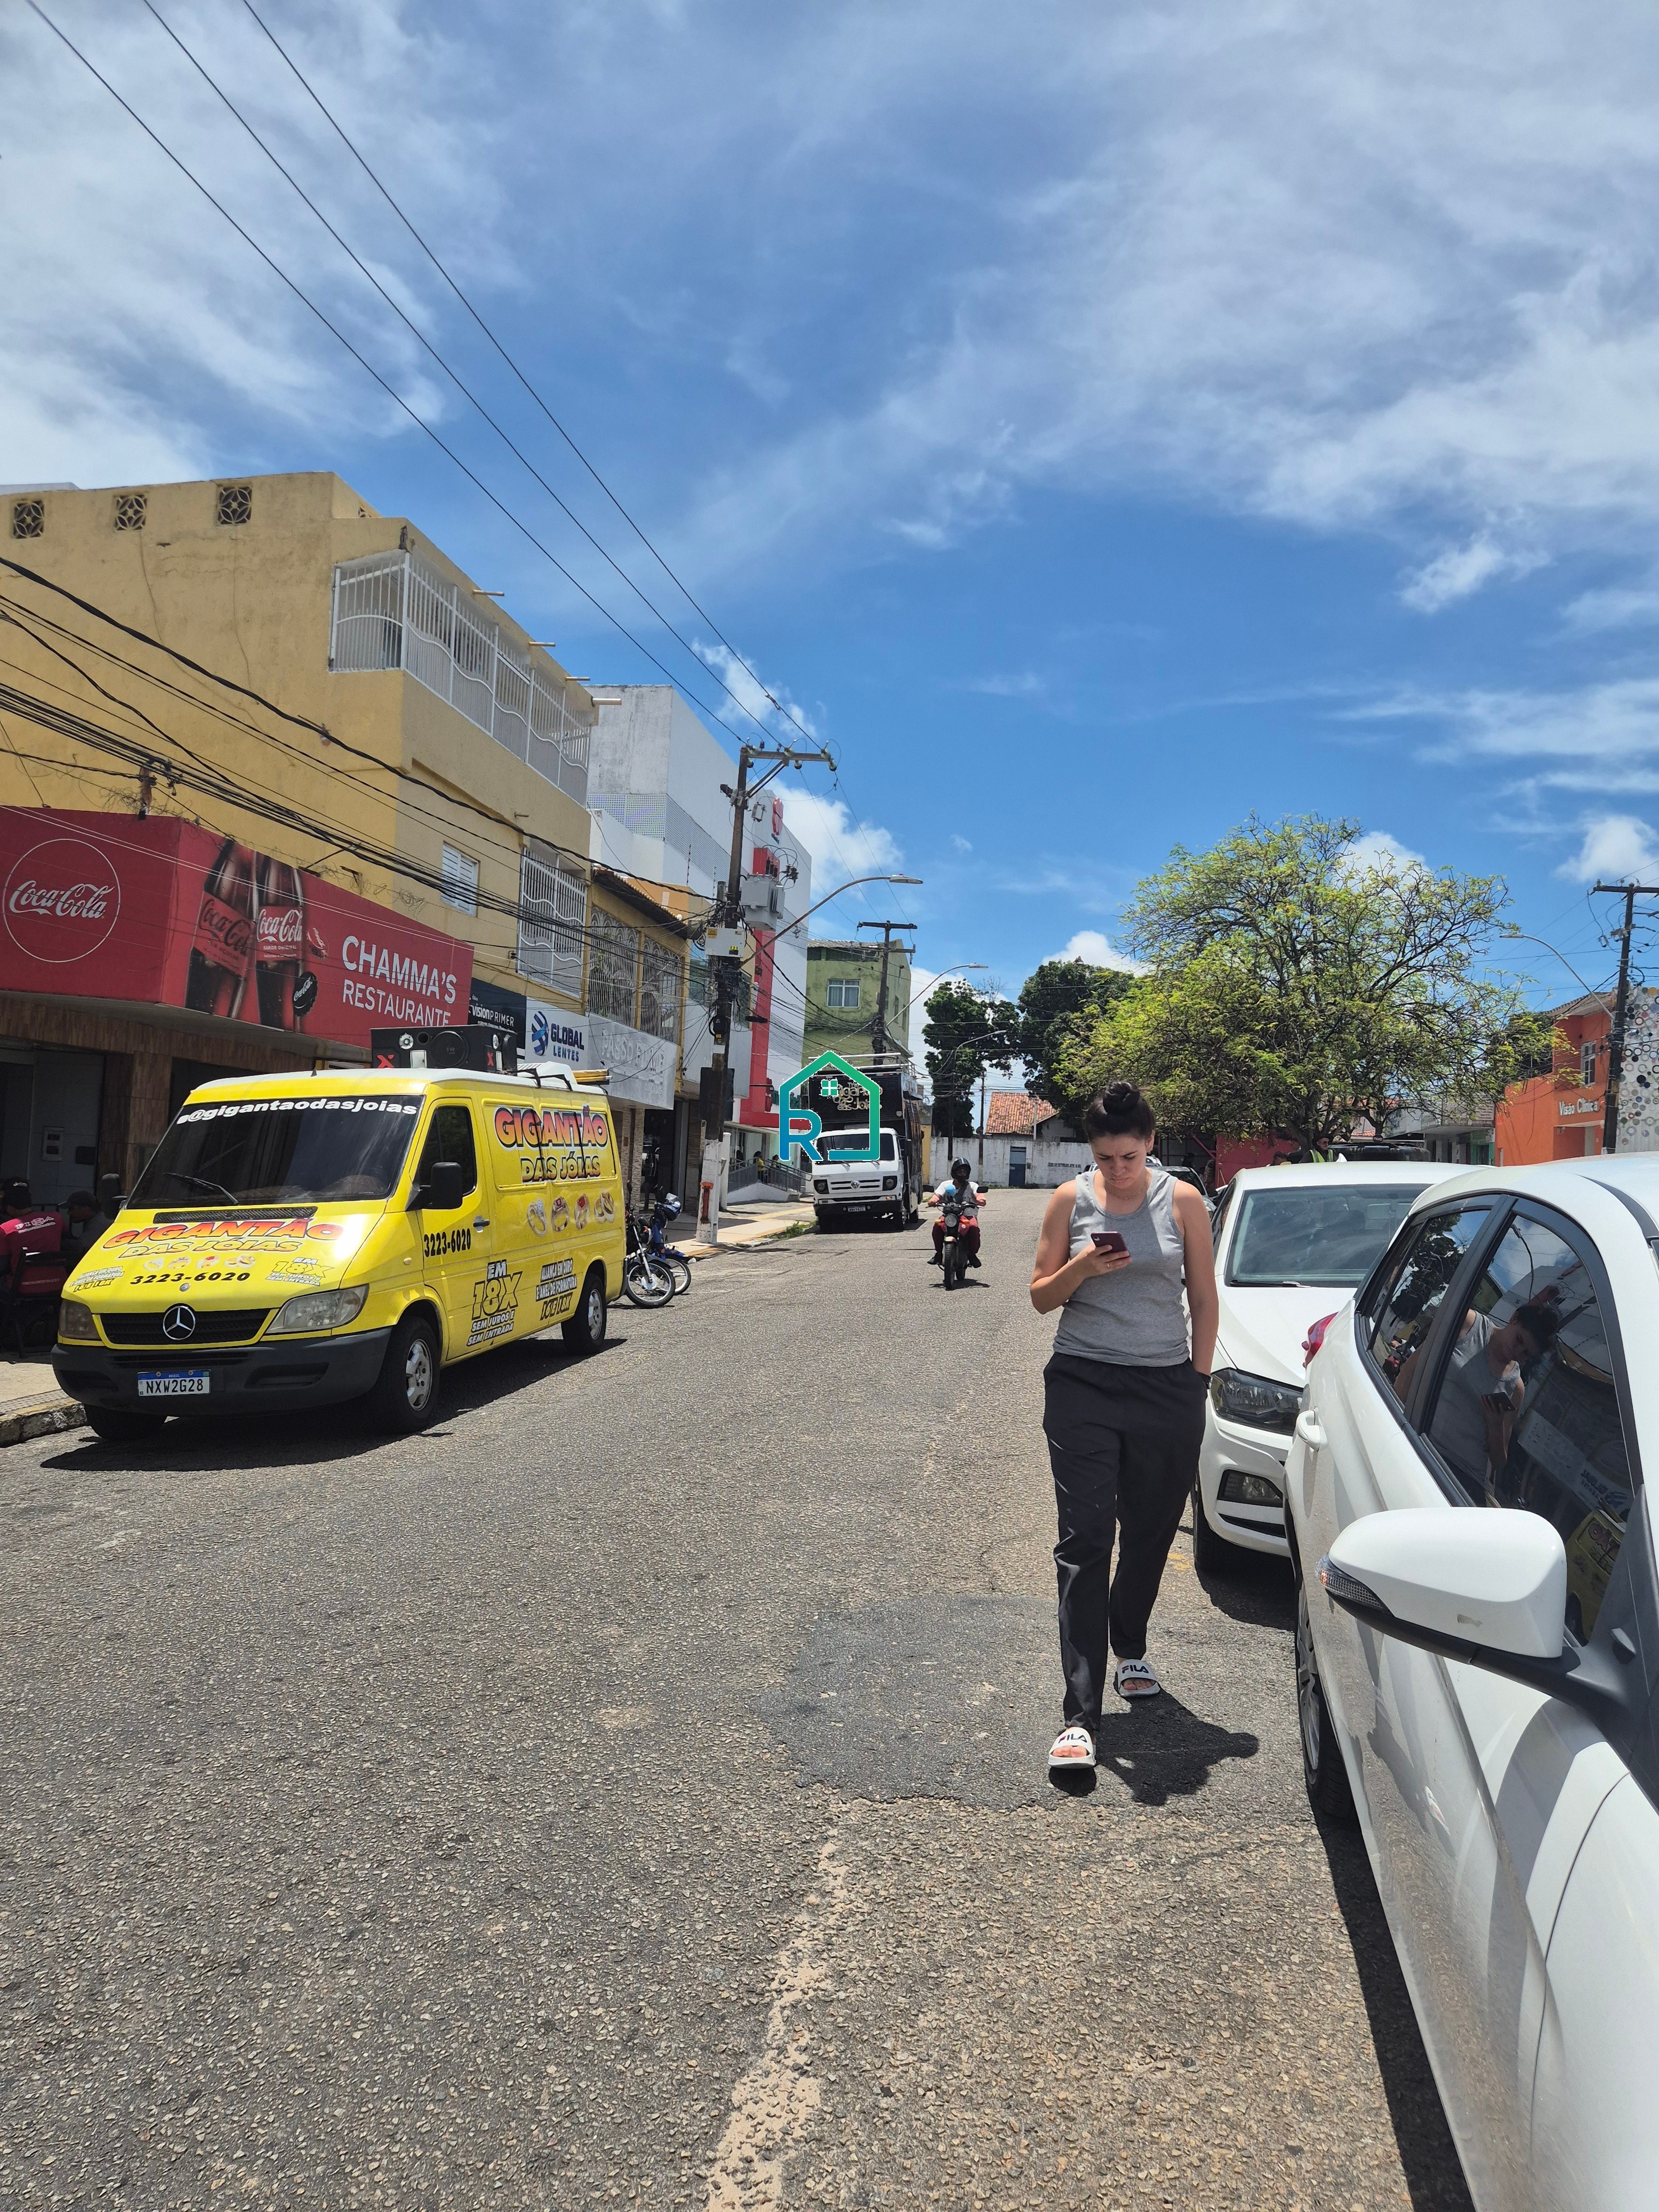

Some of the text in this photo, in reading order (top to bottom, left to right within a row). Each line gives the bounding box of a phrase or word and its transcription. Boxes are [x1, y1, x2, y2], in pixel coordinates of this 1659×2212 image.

[9, 880, 115, 919] Coca-Cola
[342, 935, 457, 1004] CHAMMA'S
[551, 1023, 585, 1051] GLOBAL
[553, 1044, 580, 1062] LENTES
[186, 1099, 419, 1122] @gigantaodasjoias
[494, 1105, 608, 1148] GIGANTÃO
[103, 1217, 344, 1249] GIGANTÃO
[424, 1228, 471, 1257] 3223-6020
[117, 1237, 302, 1258] DAS JÓIAS
[130, 1272, 251, 1284] 3223-6020
[272, 1261, 335, 1278] 18X
[487, 1259, 508, 1282] EM
[472, 1271, 523, 1321] 18X
[471, 1309, 515, 1333] SEM JUROS E
[466, 1321, 514, 1346] SEM ENTRADA
[146, 1378, 204, 1394] NXW2G28
[1122, 1664, 1149, 1674] FILA
[1058, 1733, 1087, 1743] FILA
